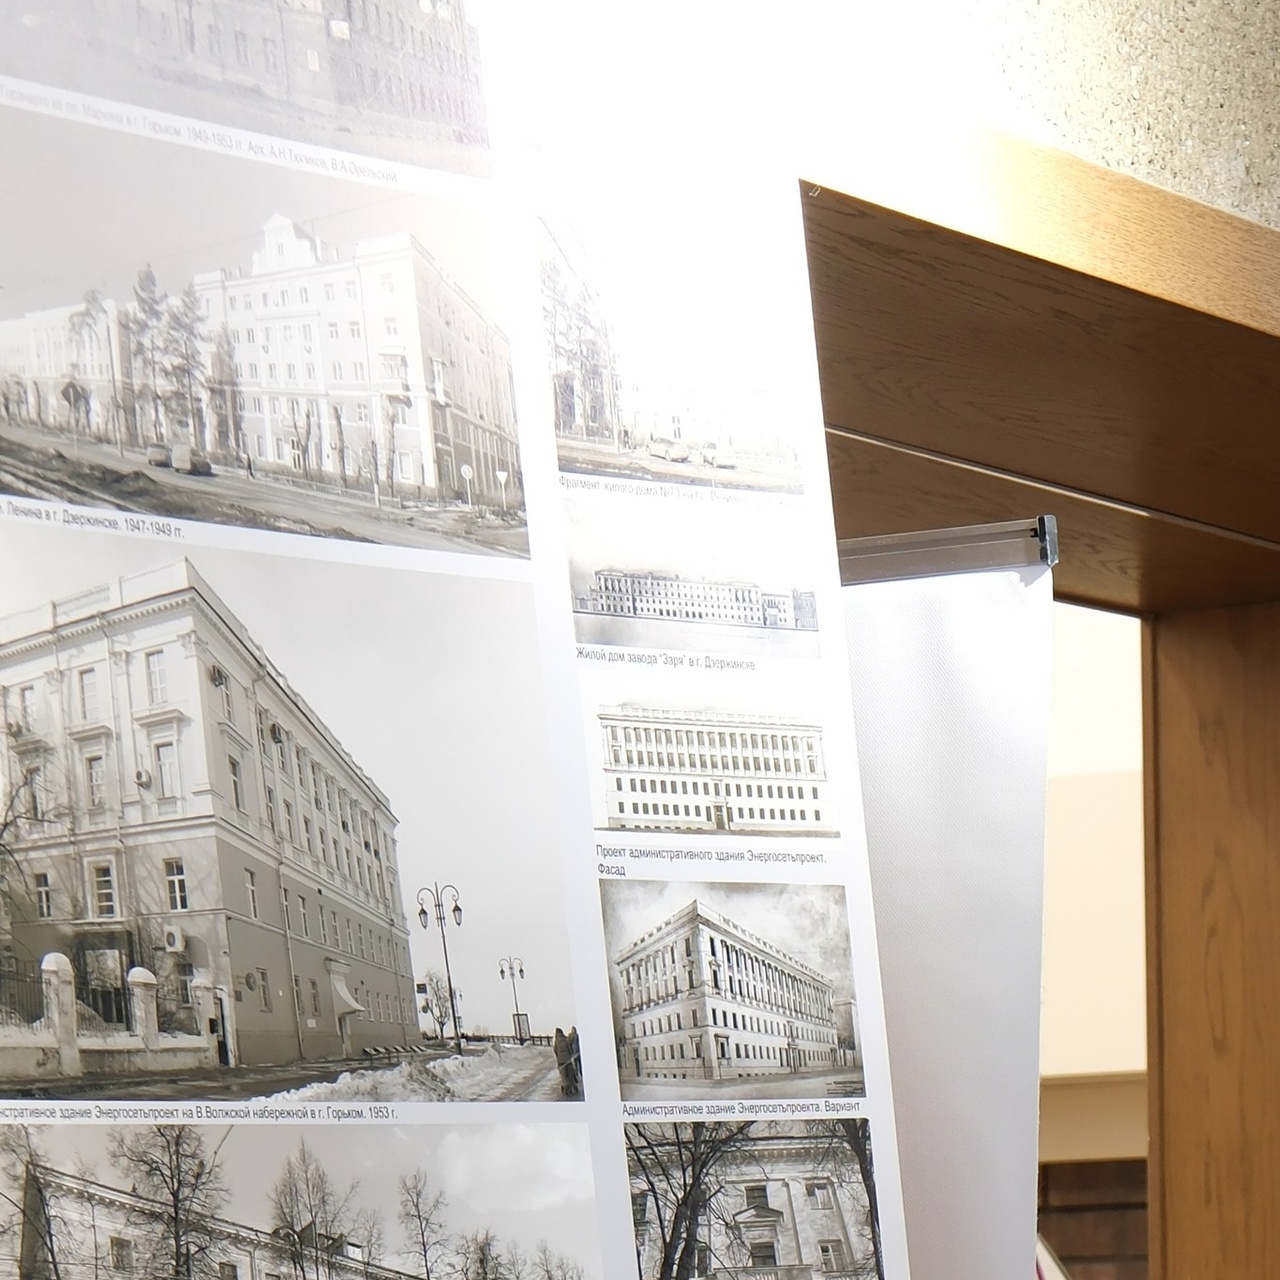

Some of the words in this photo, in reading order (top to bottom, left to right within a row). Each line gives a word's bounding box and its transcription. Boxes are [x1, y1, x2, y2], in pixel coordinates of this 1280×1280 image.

[124, 516, 172, 537] 1947-1949
[575, 646, 607, 661] Жилой
[608, 651, 625, 663] дом
[627, 652, 659, 666] завода
[704, 655, 757, 672] Дзержинске
[596, 845, 627, 859] Проект
[628, 848, 713, 863] административного
[714, 850, 745, 862] здания
[597, 863, 627, 877] Фасад
[59, 1106, 91, 1121] здание
[182, 1107, 194, 1119] на
[252, 1105, 309, 1122] набережной
[326, 1105, 367, 1122] Горьком.
[368, 1106, 390, 1120] 1953
[621, 1103, 704, 1117] Административное
[705, 1103, 736, 1116] здание
[825, 1100, 861, 1115] Вариант
